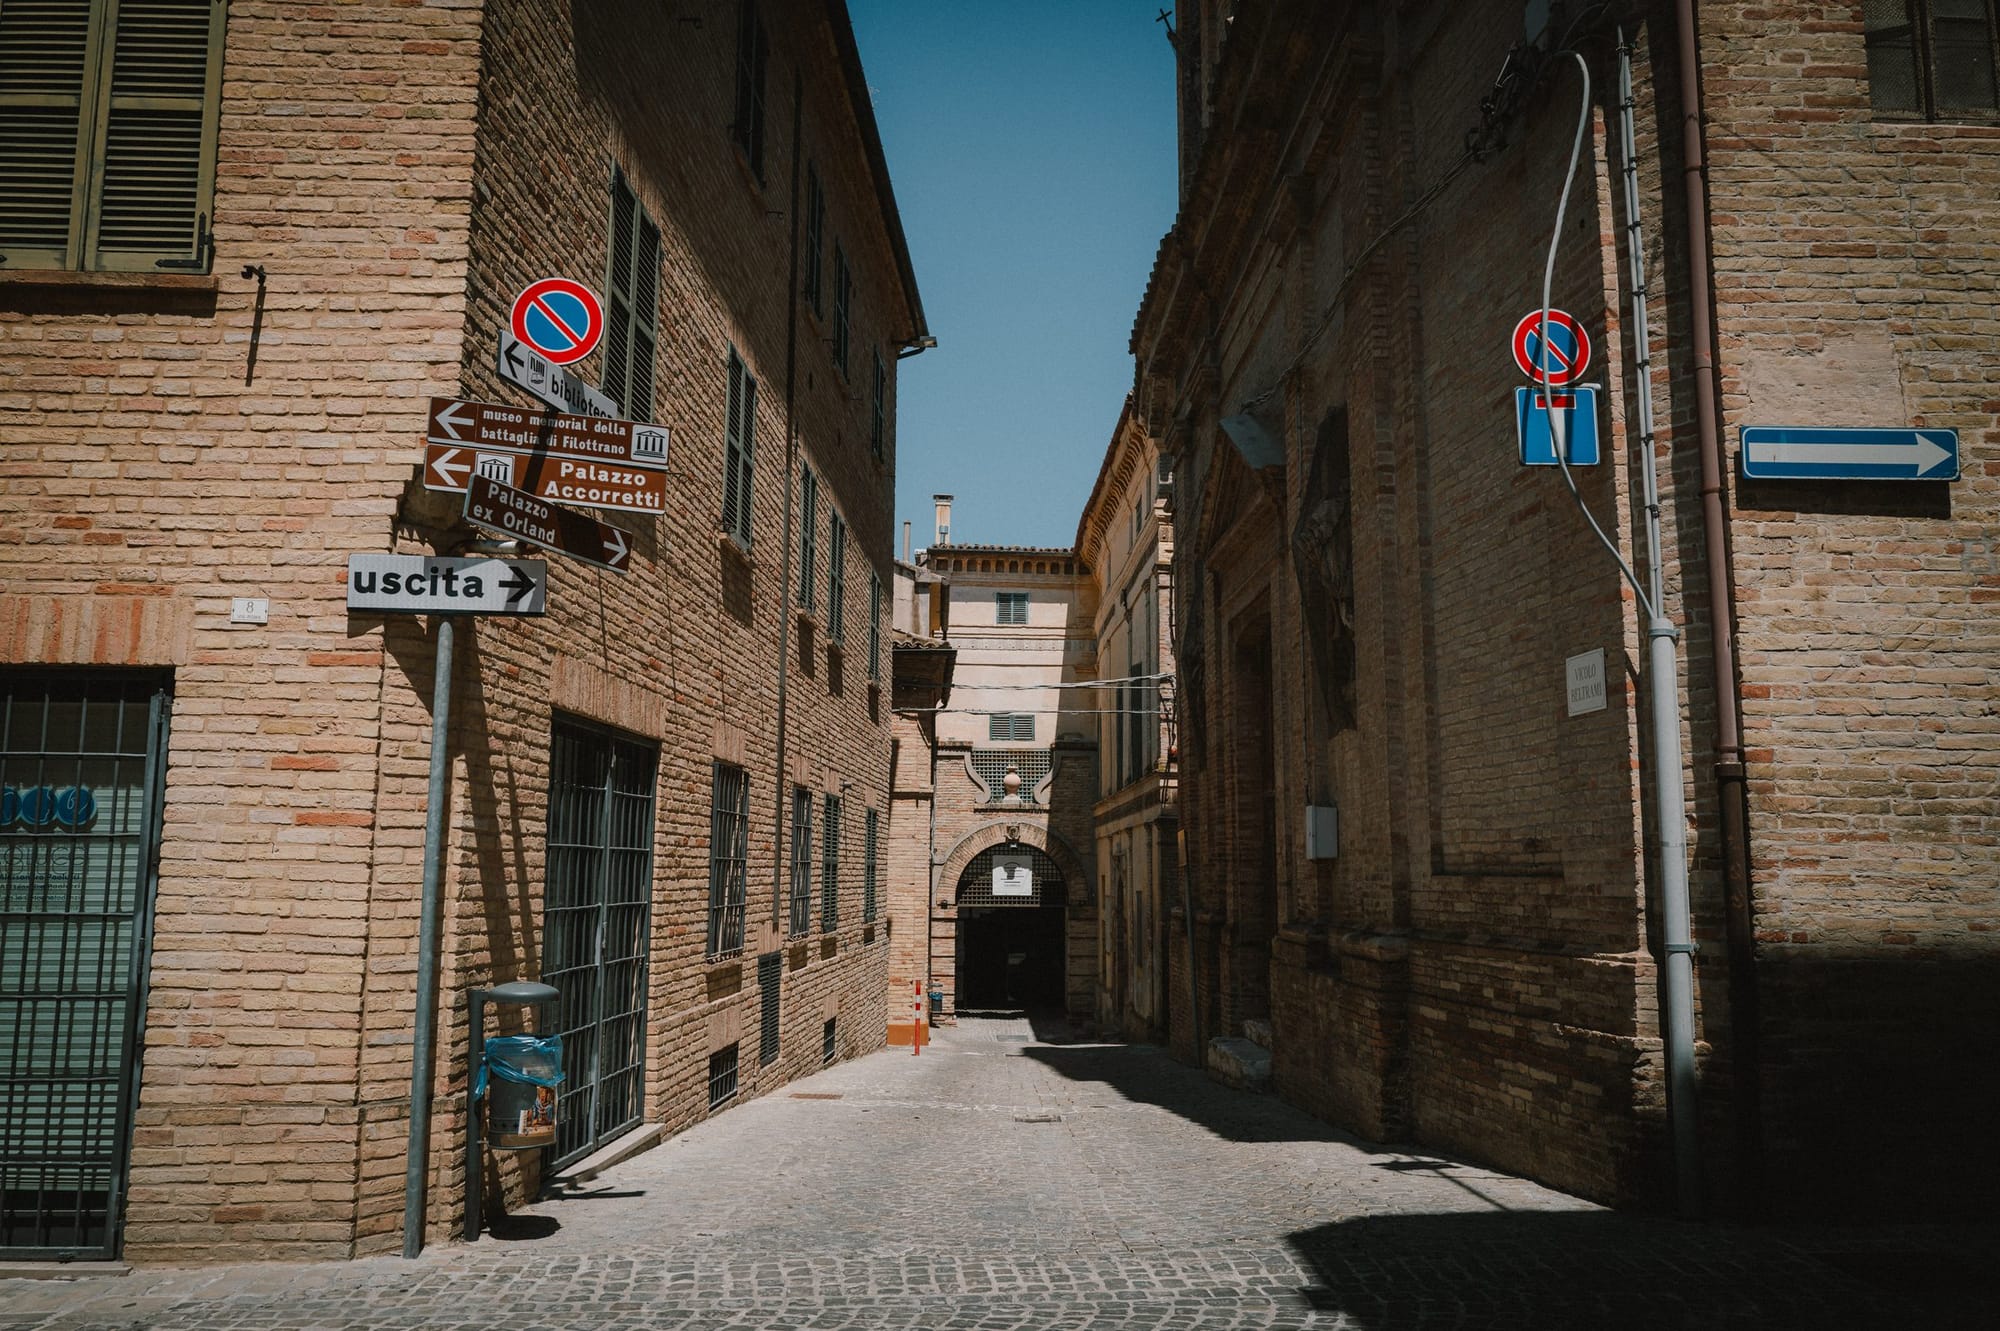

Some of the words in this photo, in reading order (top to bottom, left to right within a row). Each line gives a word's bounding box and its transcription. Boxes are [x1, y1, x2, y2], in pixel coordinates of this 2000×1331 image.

[483, 410, 522, 423] museo
[529, 414, 587, 432] memorial
[594, 421, 626, 436] della
[481, 427, 540, 445] battaglia
[546, 434, 557, 447] di
[562, 435, 625, 455] Filottrano
[560, 462, 646, 486] Palazzo
[487, 482, 549, 520] Palazzo
[544, 480, 660, 508] Accorretti
[473, 503, 492, 522] ex
[503, 511, 556, 545] Orland
[354, 566, 484, 598] uscita
[246, 601, 254, 613] 8
[1570, 681, 1602, 702] BELTRAMI
